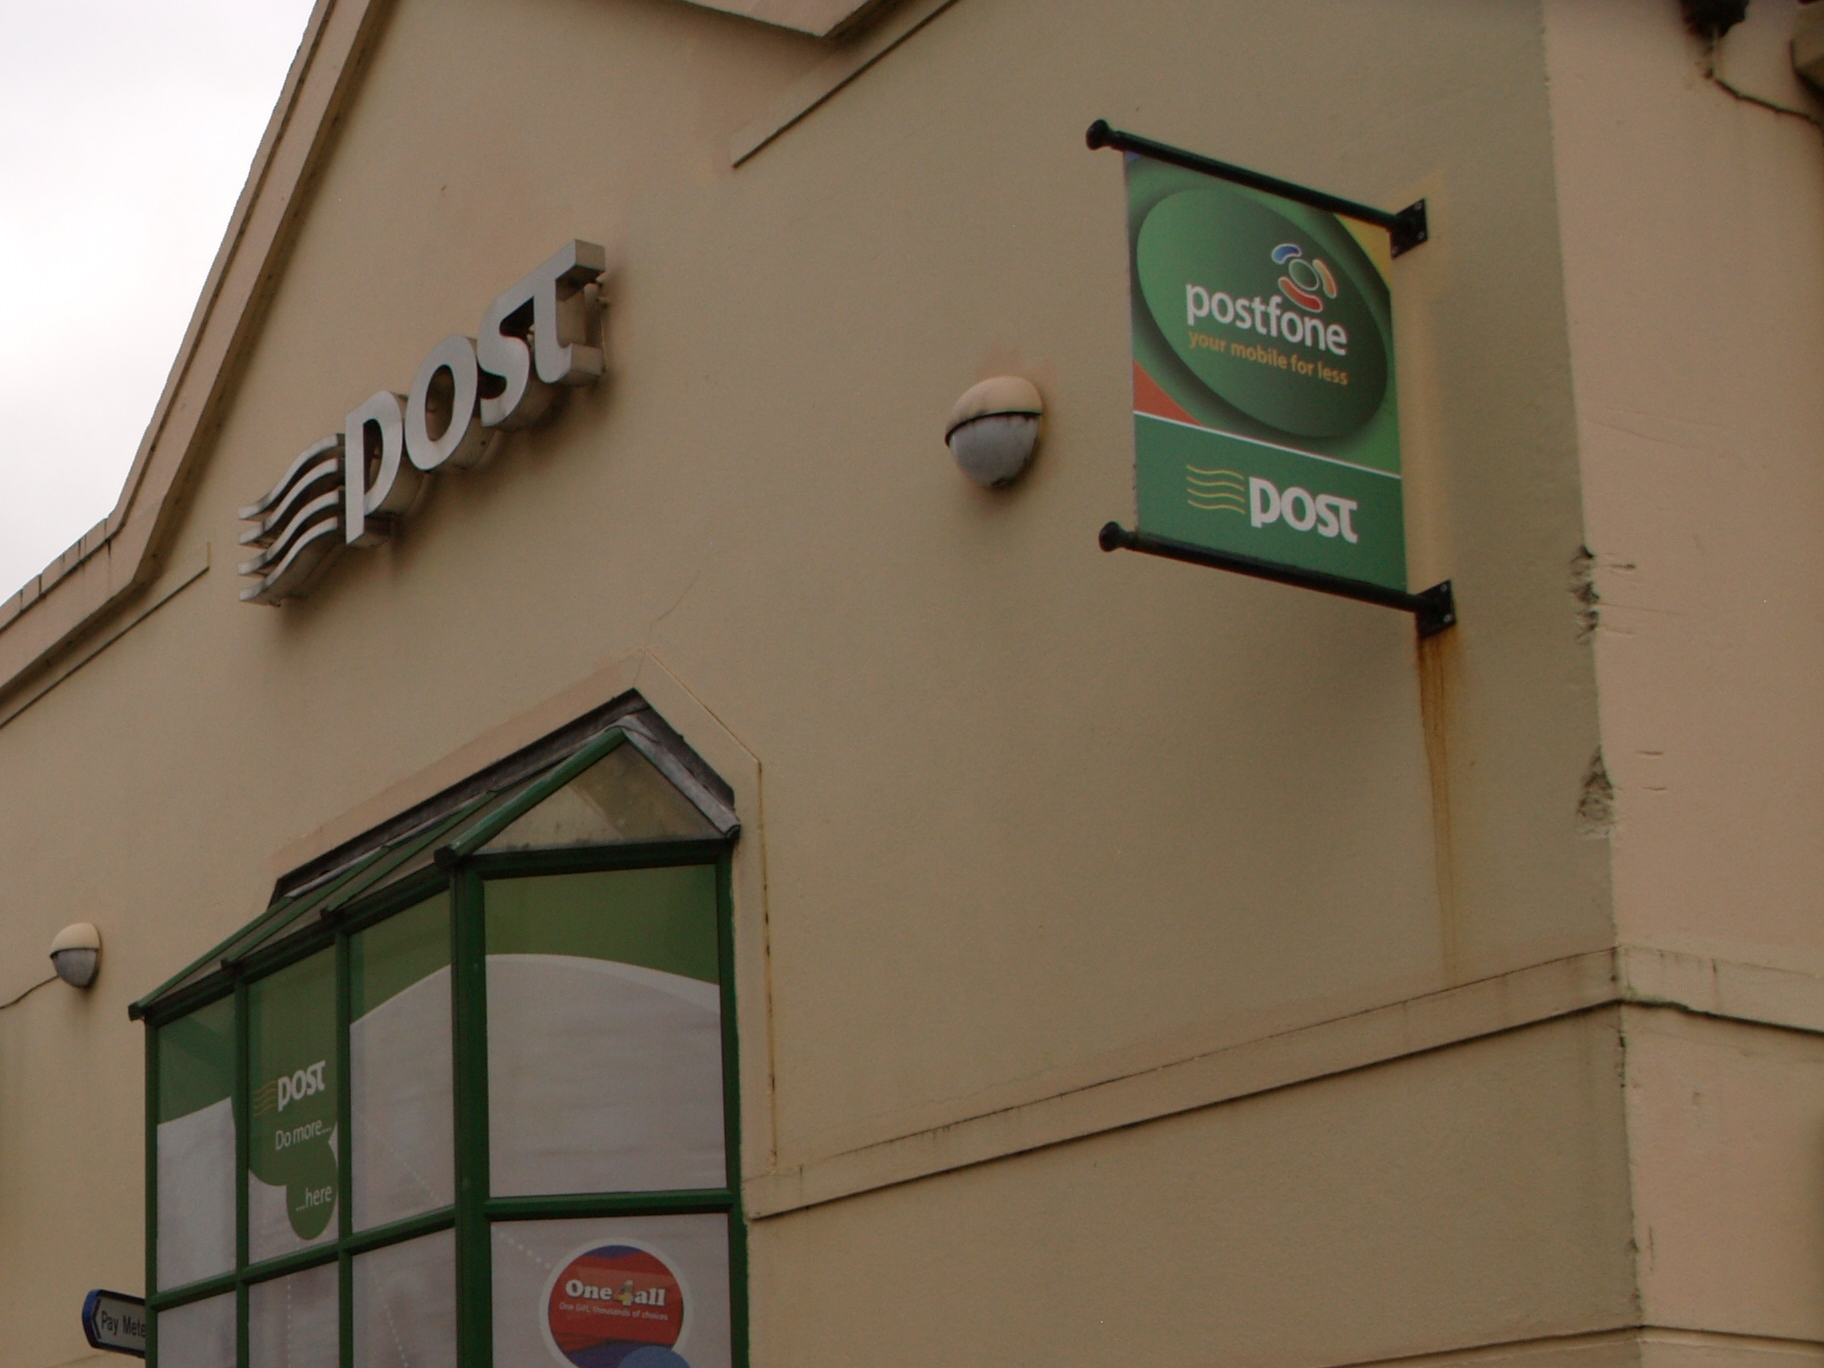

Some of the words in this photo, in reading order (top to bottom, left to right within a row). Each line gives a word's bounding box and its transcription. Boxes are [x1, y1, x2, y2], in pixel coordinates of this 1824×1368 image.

[1185, 283, 1348, 356] postfone
[1188, 331, 1227, 352] your
[1230, 341, 1288, 370] mobile
[1290, 352, 1315, 377] for
[1317, 361, 1350, 386] less
[344, 239, 605, 546] post
[1248, 476, 1359, 544] post
[276, 1060, 327, 1112] post
[101, 1310, 119, 1336] Pay
